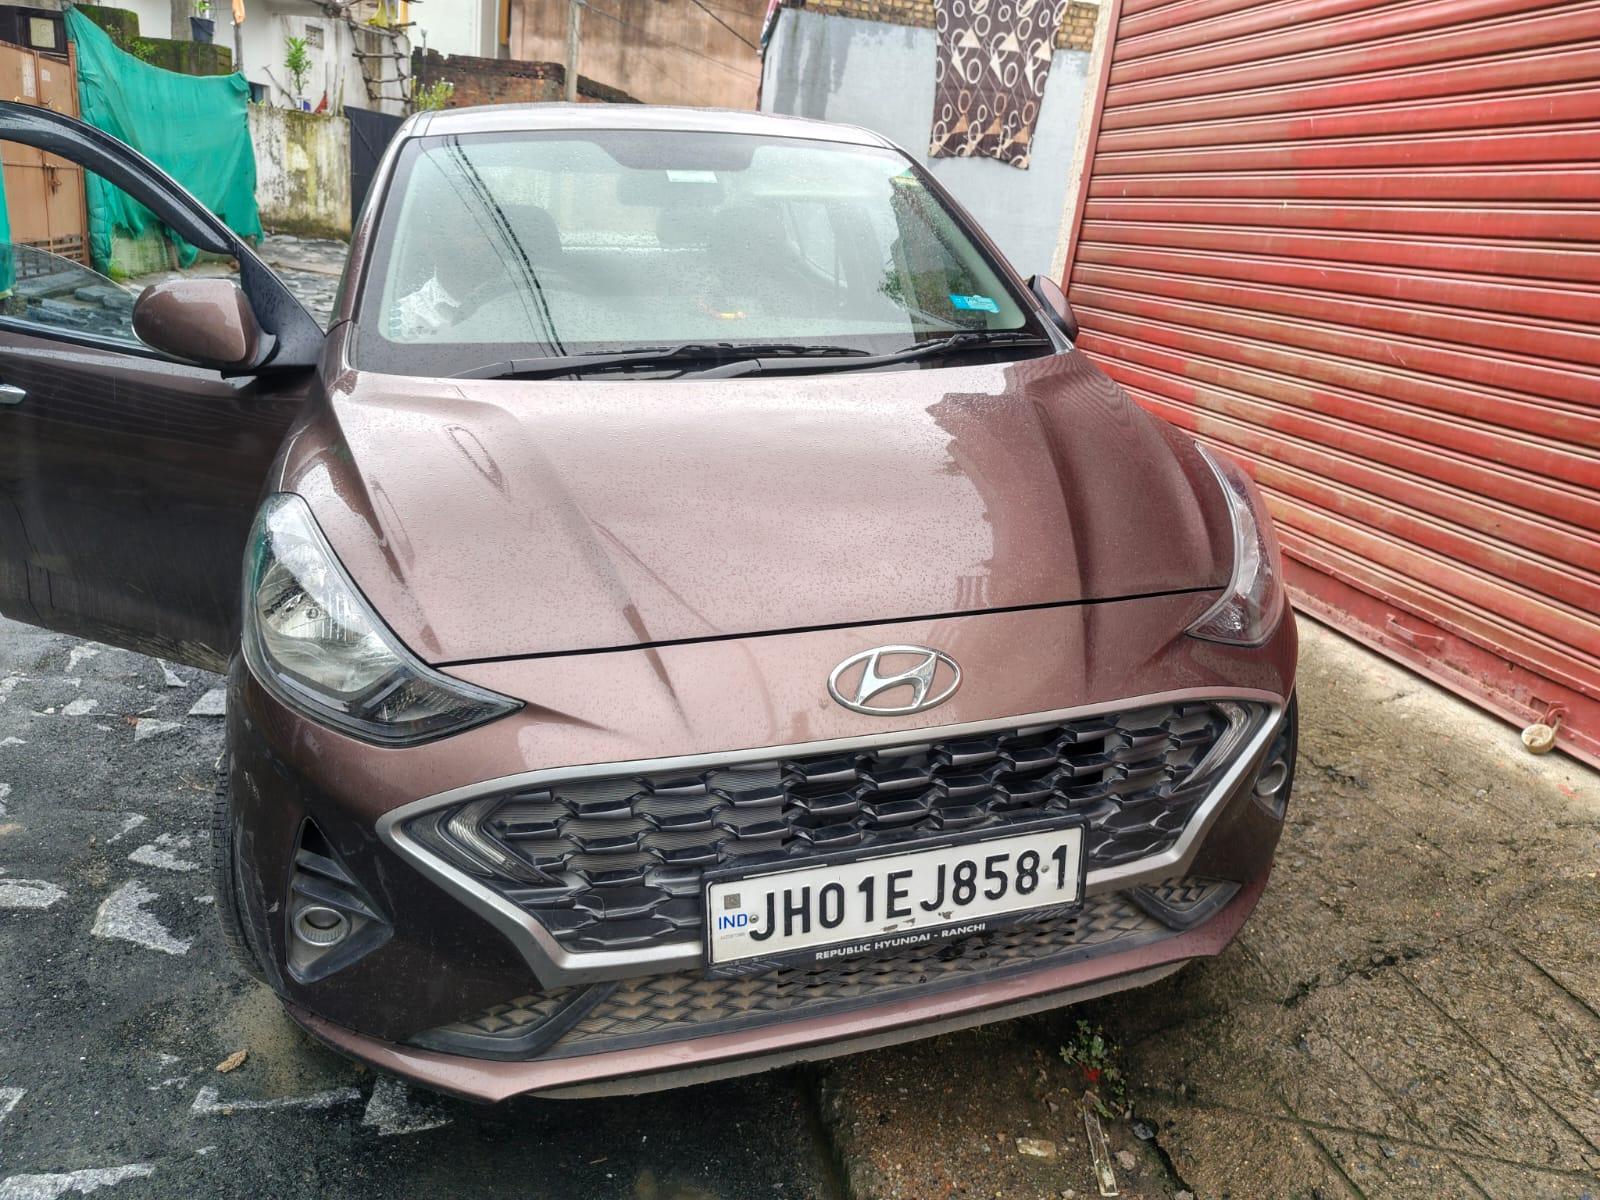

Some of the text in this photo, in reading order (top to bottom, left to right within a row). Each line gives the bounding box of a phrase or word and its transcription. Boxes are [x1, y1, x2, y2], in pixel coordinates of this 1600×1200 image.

[749, 844, 1068, 942] JH01EJ8581
[718, 913, 748, 930] IND
[815, 943, 871, 961] REPUBLIC
[875, 933, 931, 950] HYUNDAI
[941, 922, 987, 938] RANCHI
